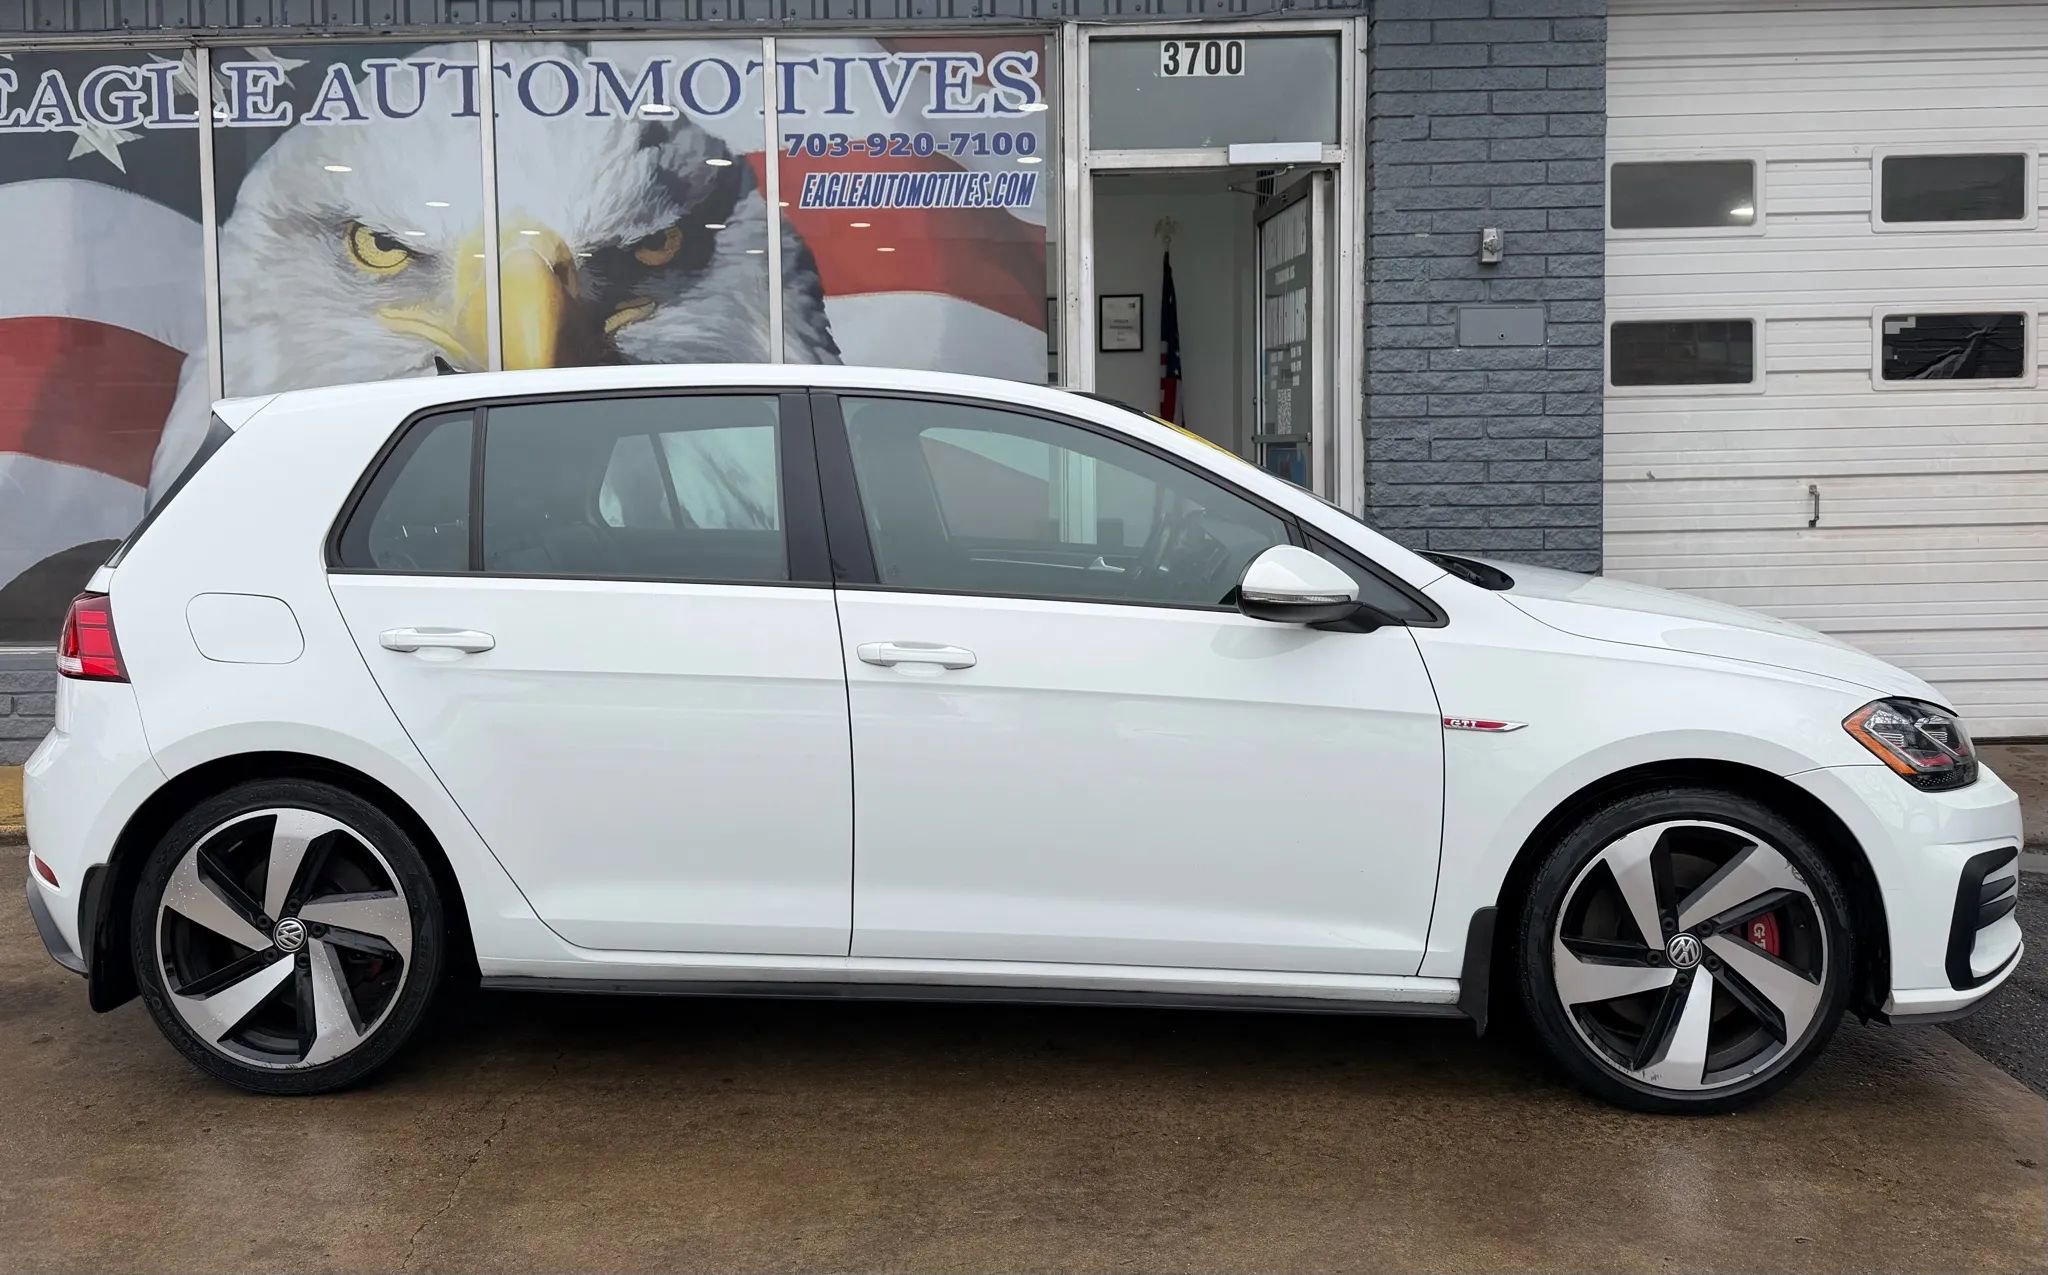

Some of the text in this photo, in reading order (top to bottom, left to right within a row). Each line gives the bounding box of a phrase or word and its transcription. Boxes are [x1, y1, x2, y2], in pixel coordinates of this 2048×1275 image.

[1163, 41, 1243, 75] 3700
[303, 53, 1039, 124] AUTOMOTIVES
[784, 132, 1037, 157] 703-920-7100
[799, 171, 1038, 208] EAGLEAUTOMOTIVES.COM
[1450, 719, 1477, 728] GTI
